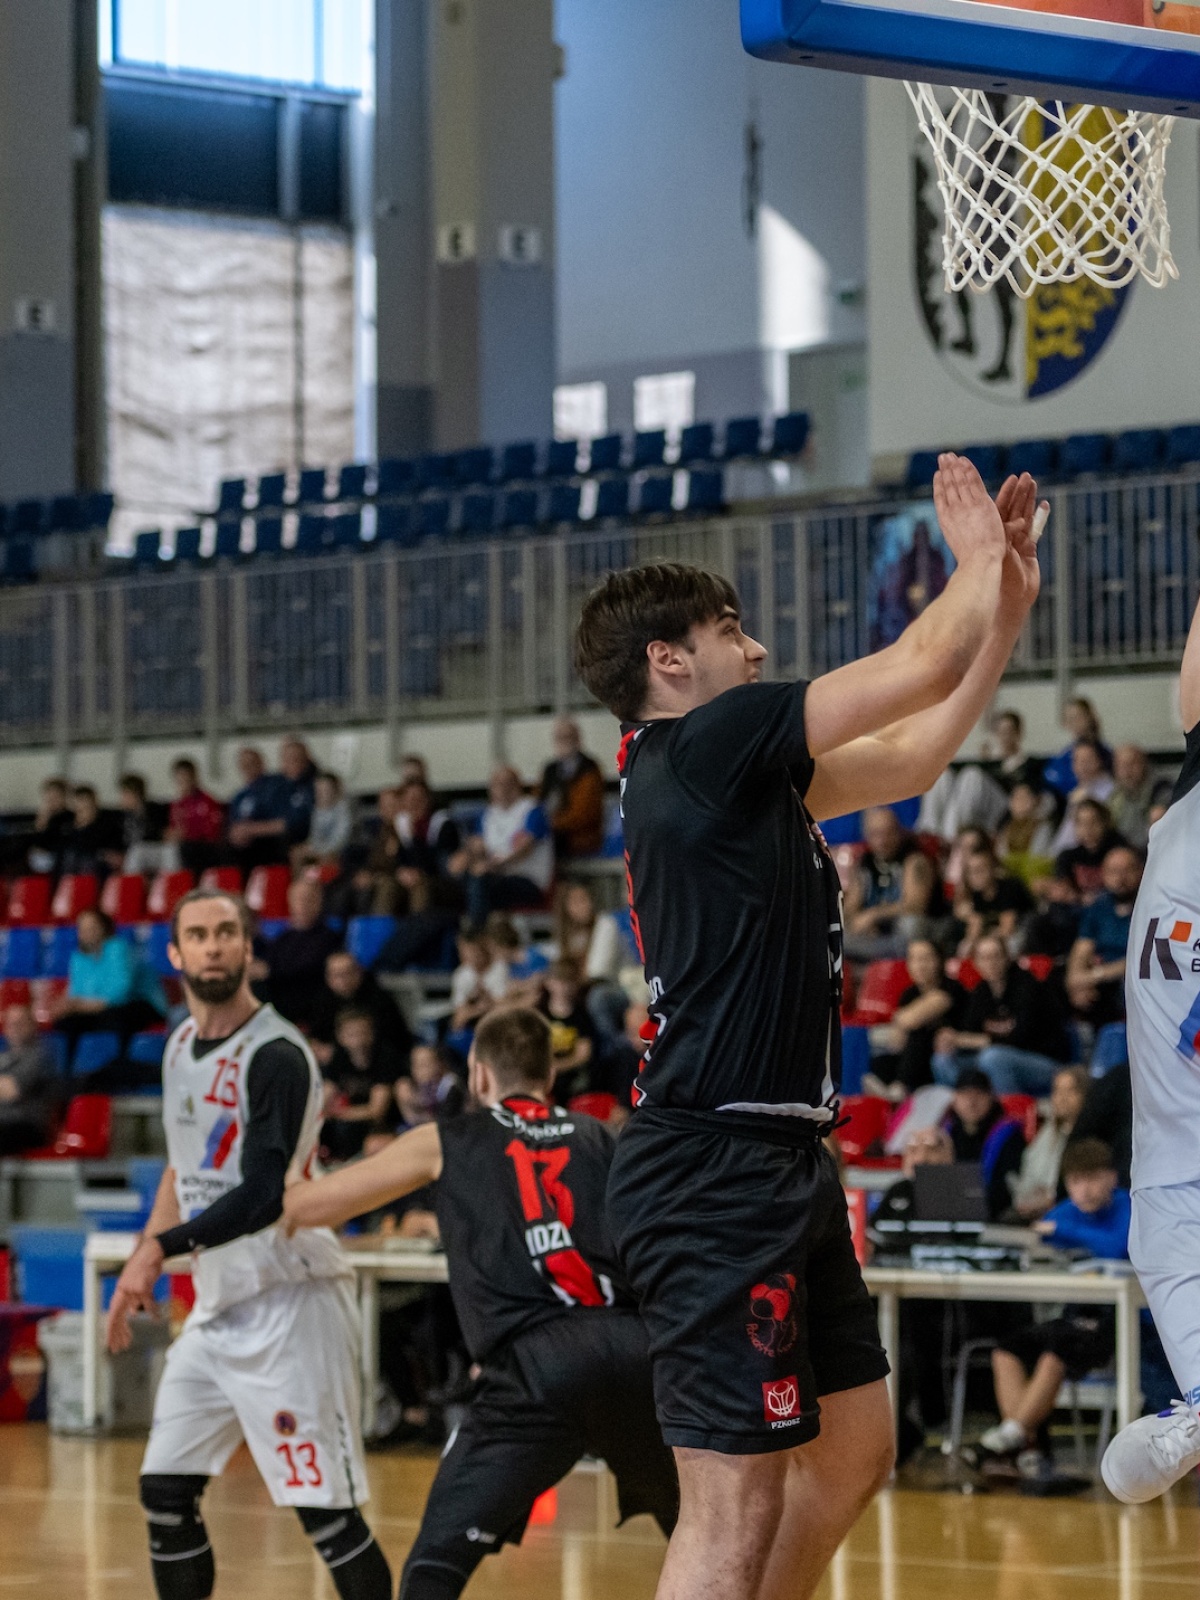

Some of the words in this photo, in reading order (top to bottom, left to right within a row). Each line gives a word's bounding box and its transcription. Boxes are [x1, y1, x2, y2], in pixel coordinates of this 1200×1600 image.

[204, 1057, 239, 1108] 13
[505, 1139, 575, 1228] 13
[276, 1443, 323, 1488] 13
